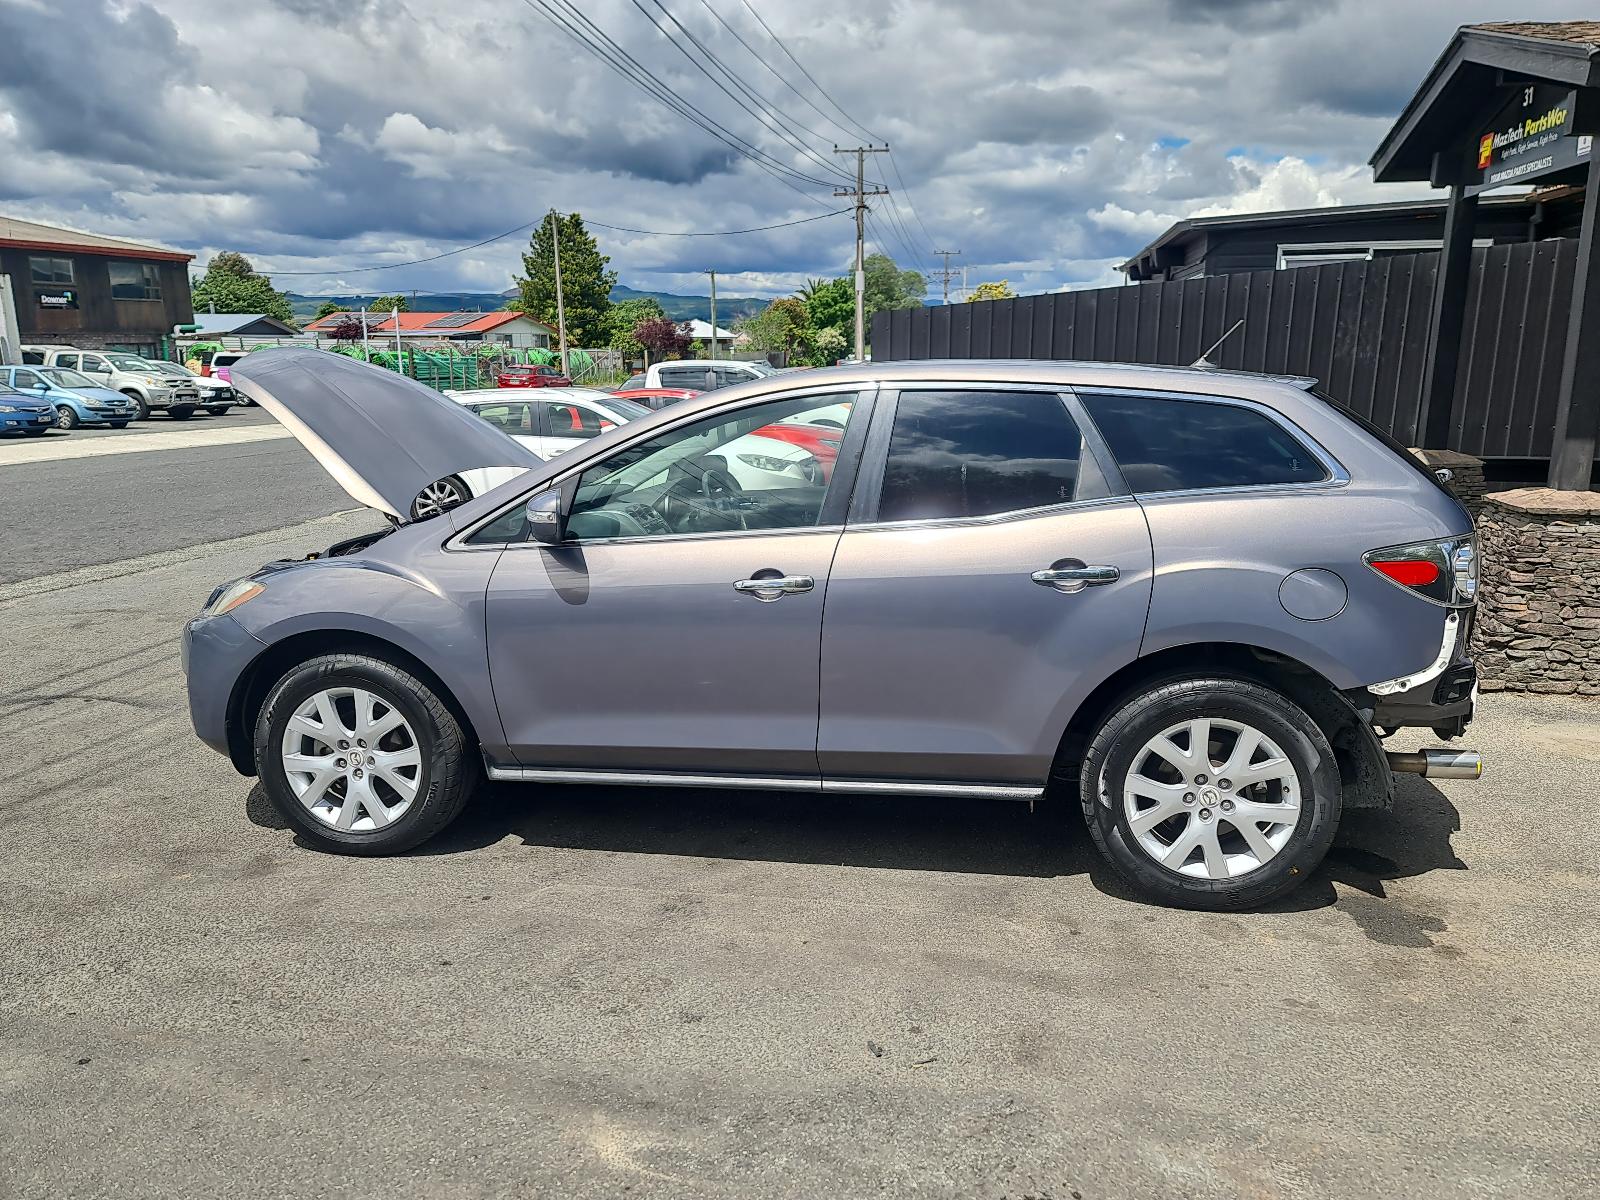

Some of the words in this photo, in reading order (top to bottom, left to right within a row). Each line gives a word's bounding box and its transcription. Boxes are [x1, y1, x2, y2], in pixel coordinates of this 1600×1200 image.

[1522, 86, 1534, 107] 31
[1524, 107, 1567, 137] PartsWor
[40, 294, 68, 304] Downer
